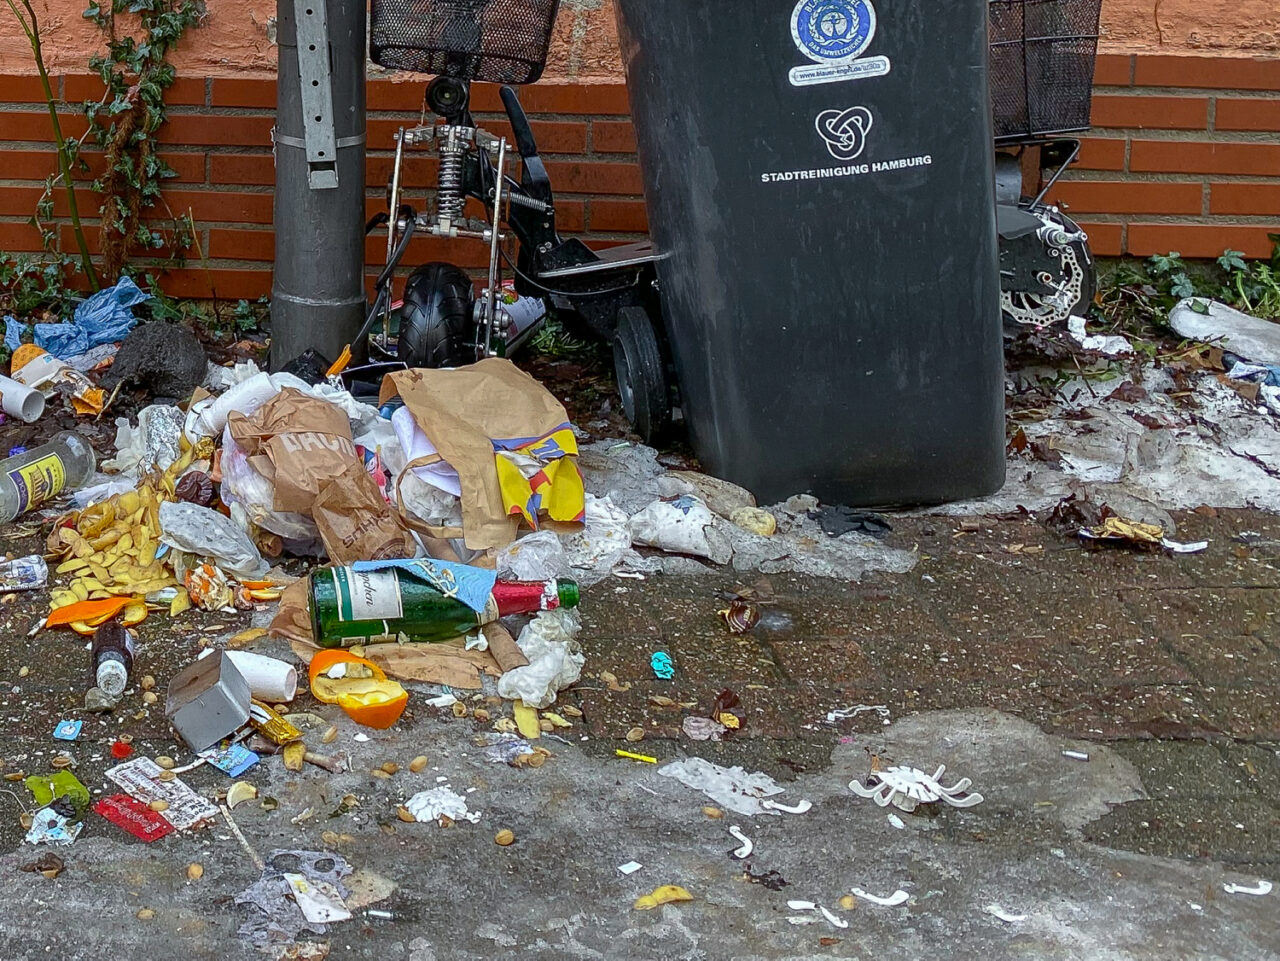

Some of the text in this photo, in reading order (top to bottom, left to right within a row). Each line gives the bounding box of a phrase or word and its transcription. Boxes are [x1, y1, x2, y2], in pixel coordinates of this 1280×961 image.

[808, 35, 865, 56] DAS UMWELTZEICHEN
[761, 155, 932, 182] STADTREINIGUNG HAMBURG
